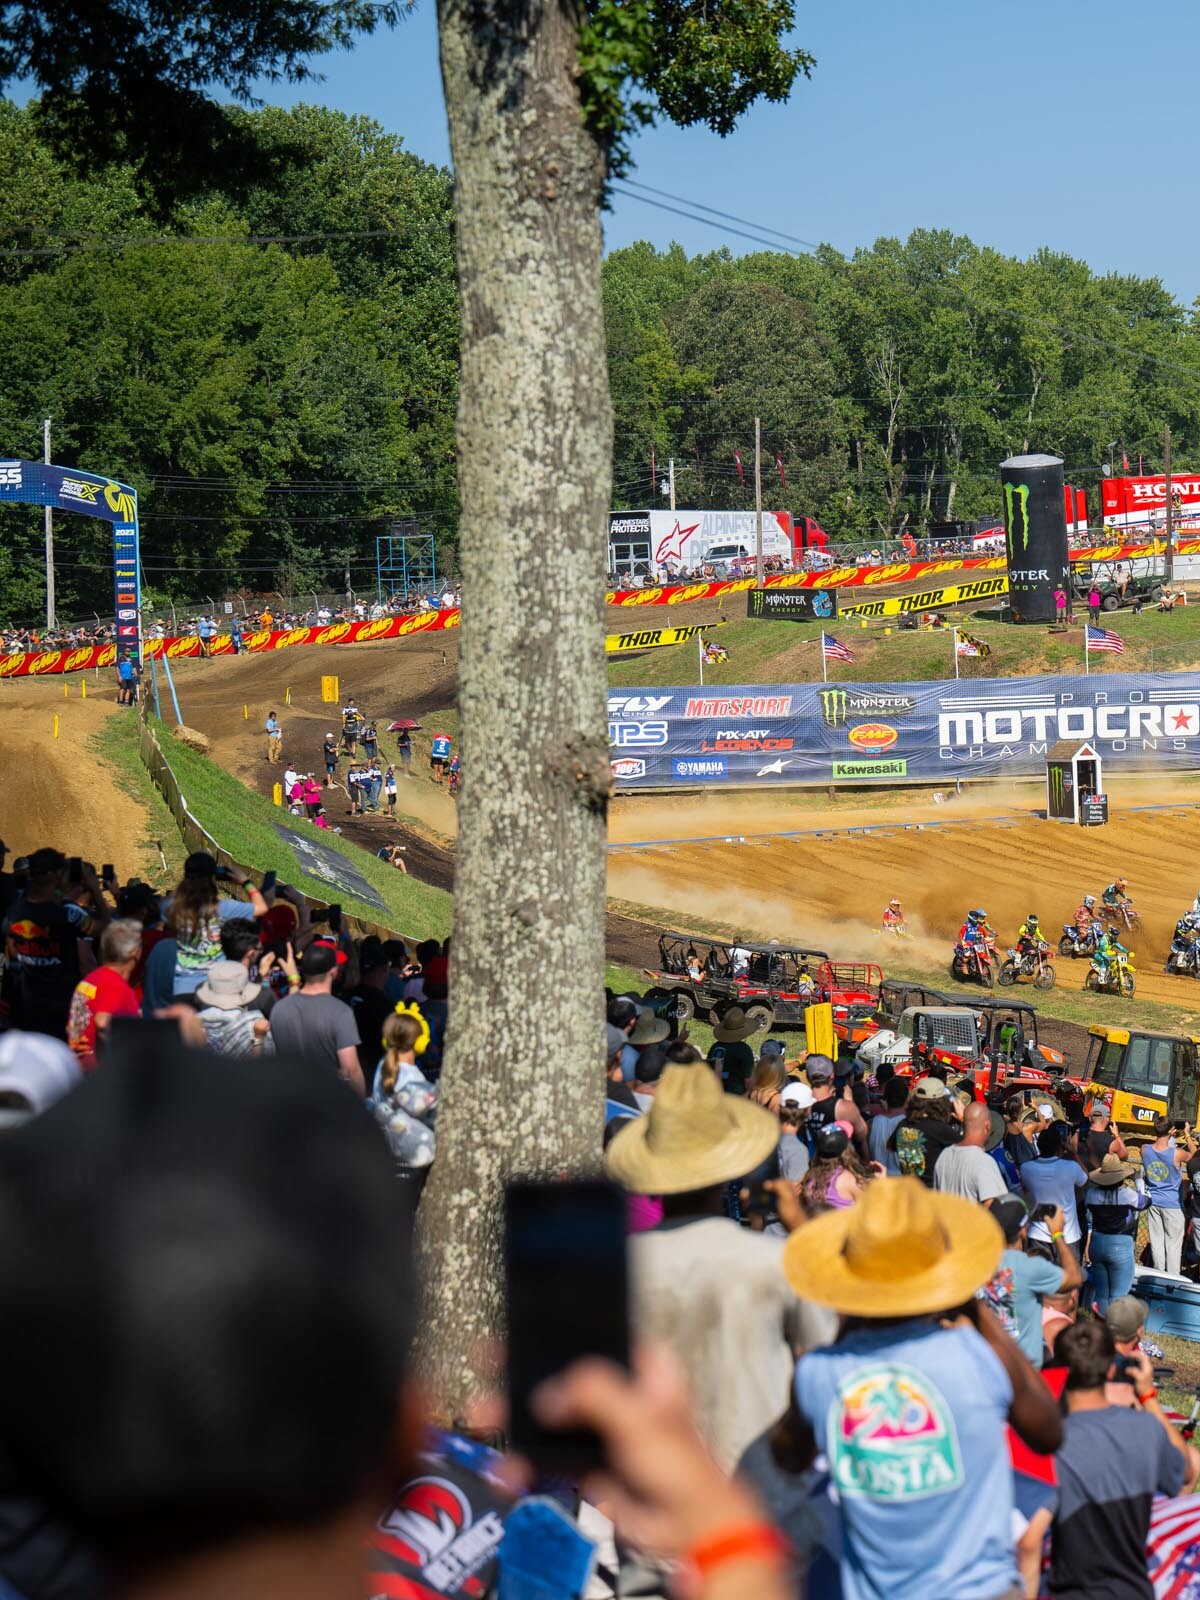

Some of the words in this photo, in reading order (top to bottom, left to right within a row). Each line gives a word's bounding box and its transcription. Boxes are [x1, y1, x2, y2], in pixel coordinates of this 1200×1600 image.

[611, 524, 650, 534] PROTECTS
[864, 564, 911, 585] FMF
[621, 588, 662, 607] FMF
[668, 584, 710, 605] FMF
[957, 579, 1004, 599] THOR
[765, 594, 806, 606] MONSTER
[841, 602, 885, 617] THOR
[898, 591, 943, 611] THOR
[356, 618, 393, 641] FMF
[399, 611, 439, 635] FMF
[275, 628, 310, 649] FMF
[315, 623, 351, 645] FMF
[619, 630, 661, 648] THOR
[167, 636, 198, 657] FMF
[29, 651, 61, 673] FMF
[64, 648, 93, 670] FMF
[686, 697, 790, 718] MOTOSPORT
[850, 697, 910, 707] MONSTER
[1061, 691, 1145, 705] PRO
[851, 729, 894, 740] FMF
[614, 762, 643, 775] 100%
[688, 762, 724, 773] YAMAHA
[836, 762, 903, 776] Kawasaki
[1138, 1109, 1155, 1122] CAT
